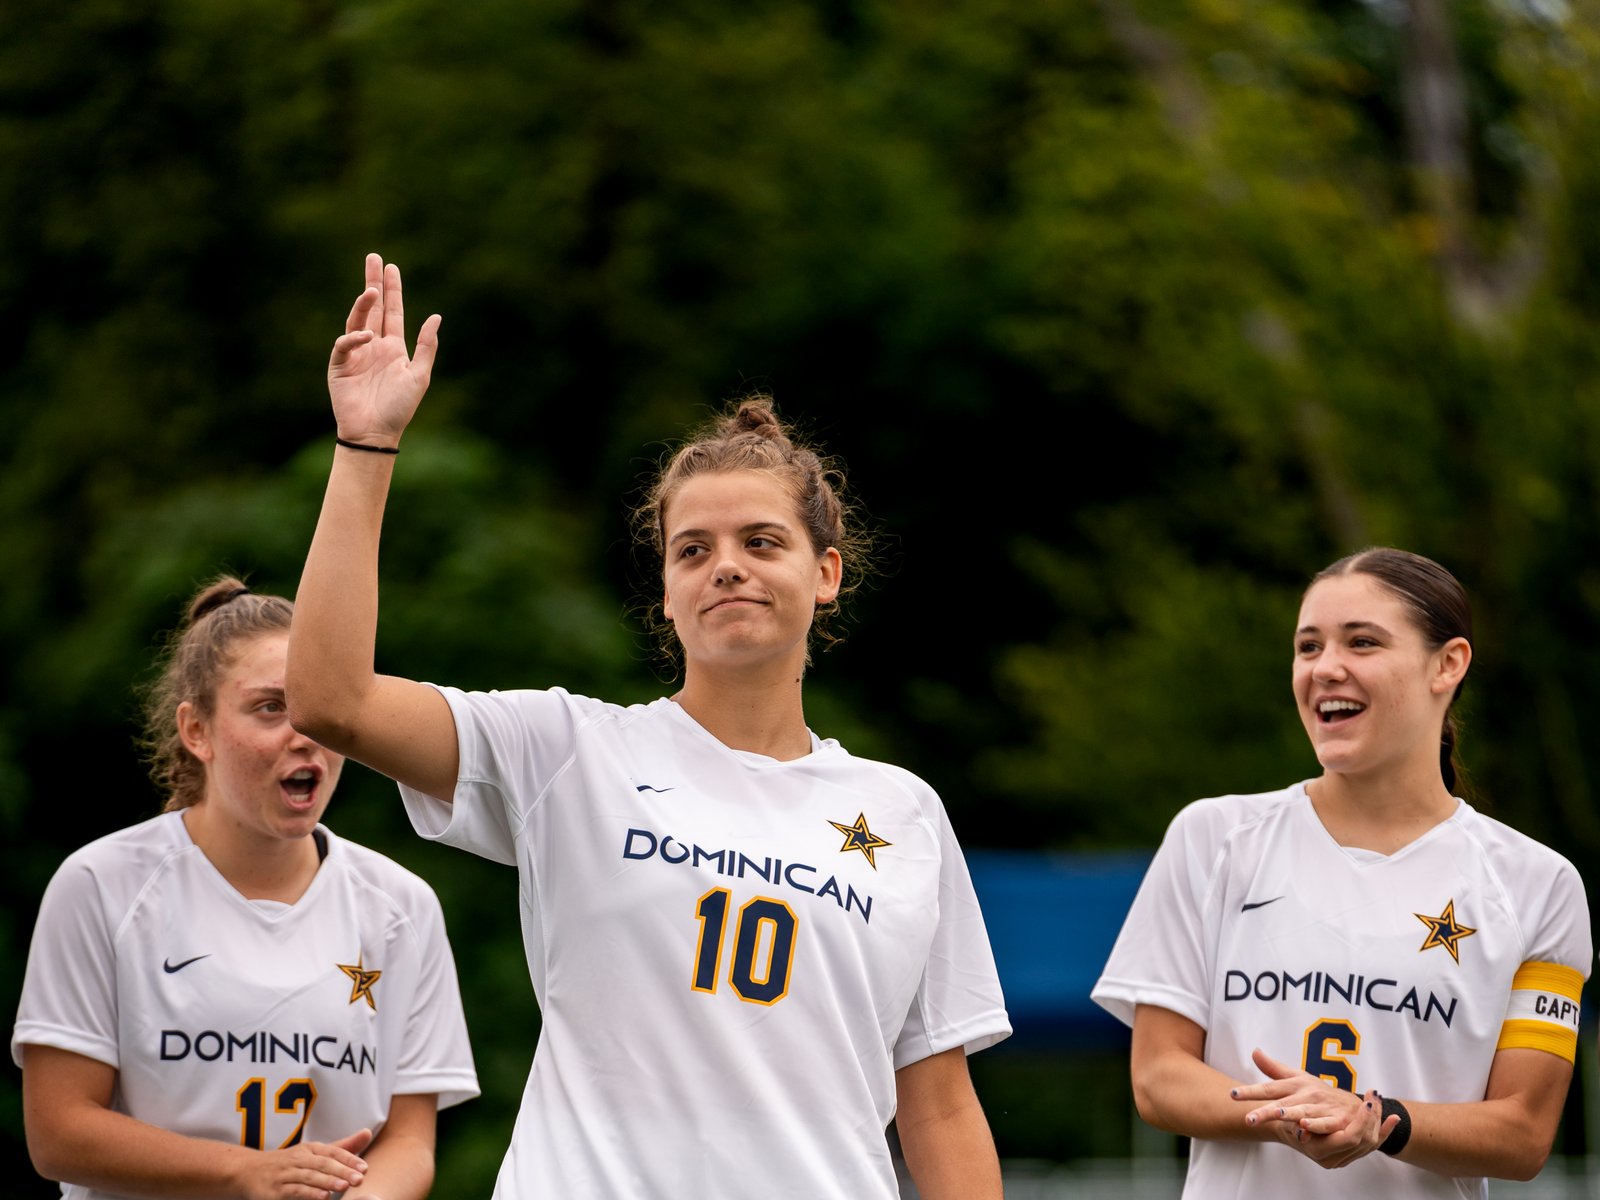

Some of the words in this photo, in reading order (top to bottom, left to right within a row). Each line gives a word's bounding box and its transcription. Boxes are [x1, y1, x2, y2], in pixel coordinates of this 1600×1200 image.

[622, 828, 873, 925] DOMINICAN
[691, 886, 799, 1007] 10
[1224, 970, 1458, 1029] DOMINICAN
[1535, 995, 1580, 1027] CAPT
[160, 1030, 376, 1075] DOMINICAN
[1301, 1017, 1361, 1094] 6
[236, 1077, 318, 1151] 12
